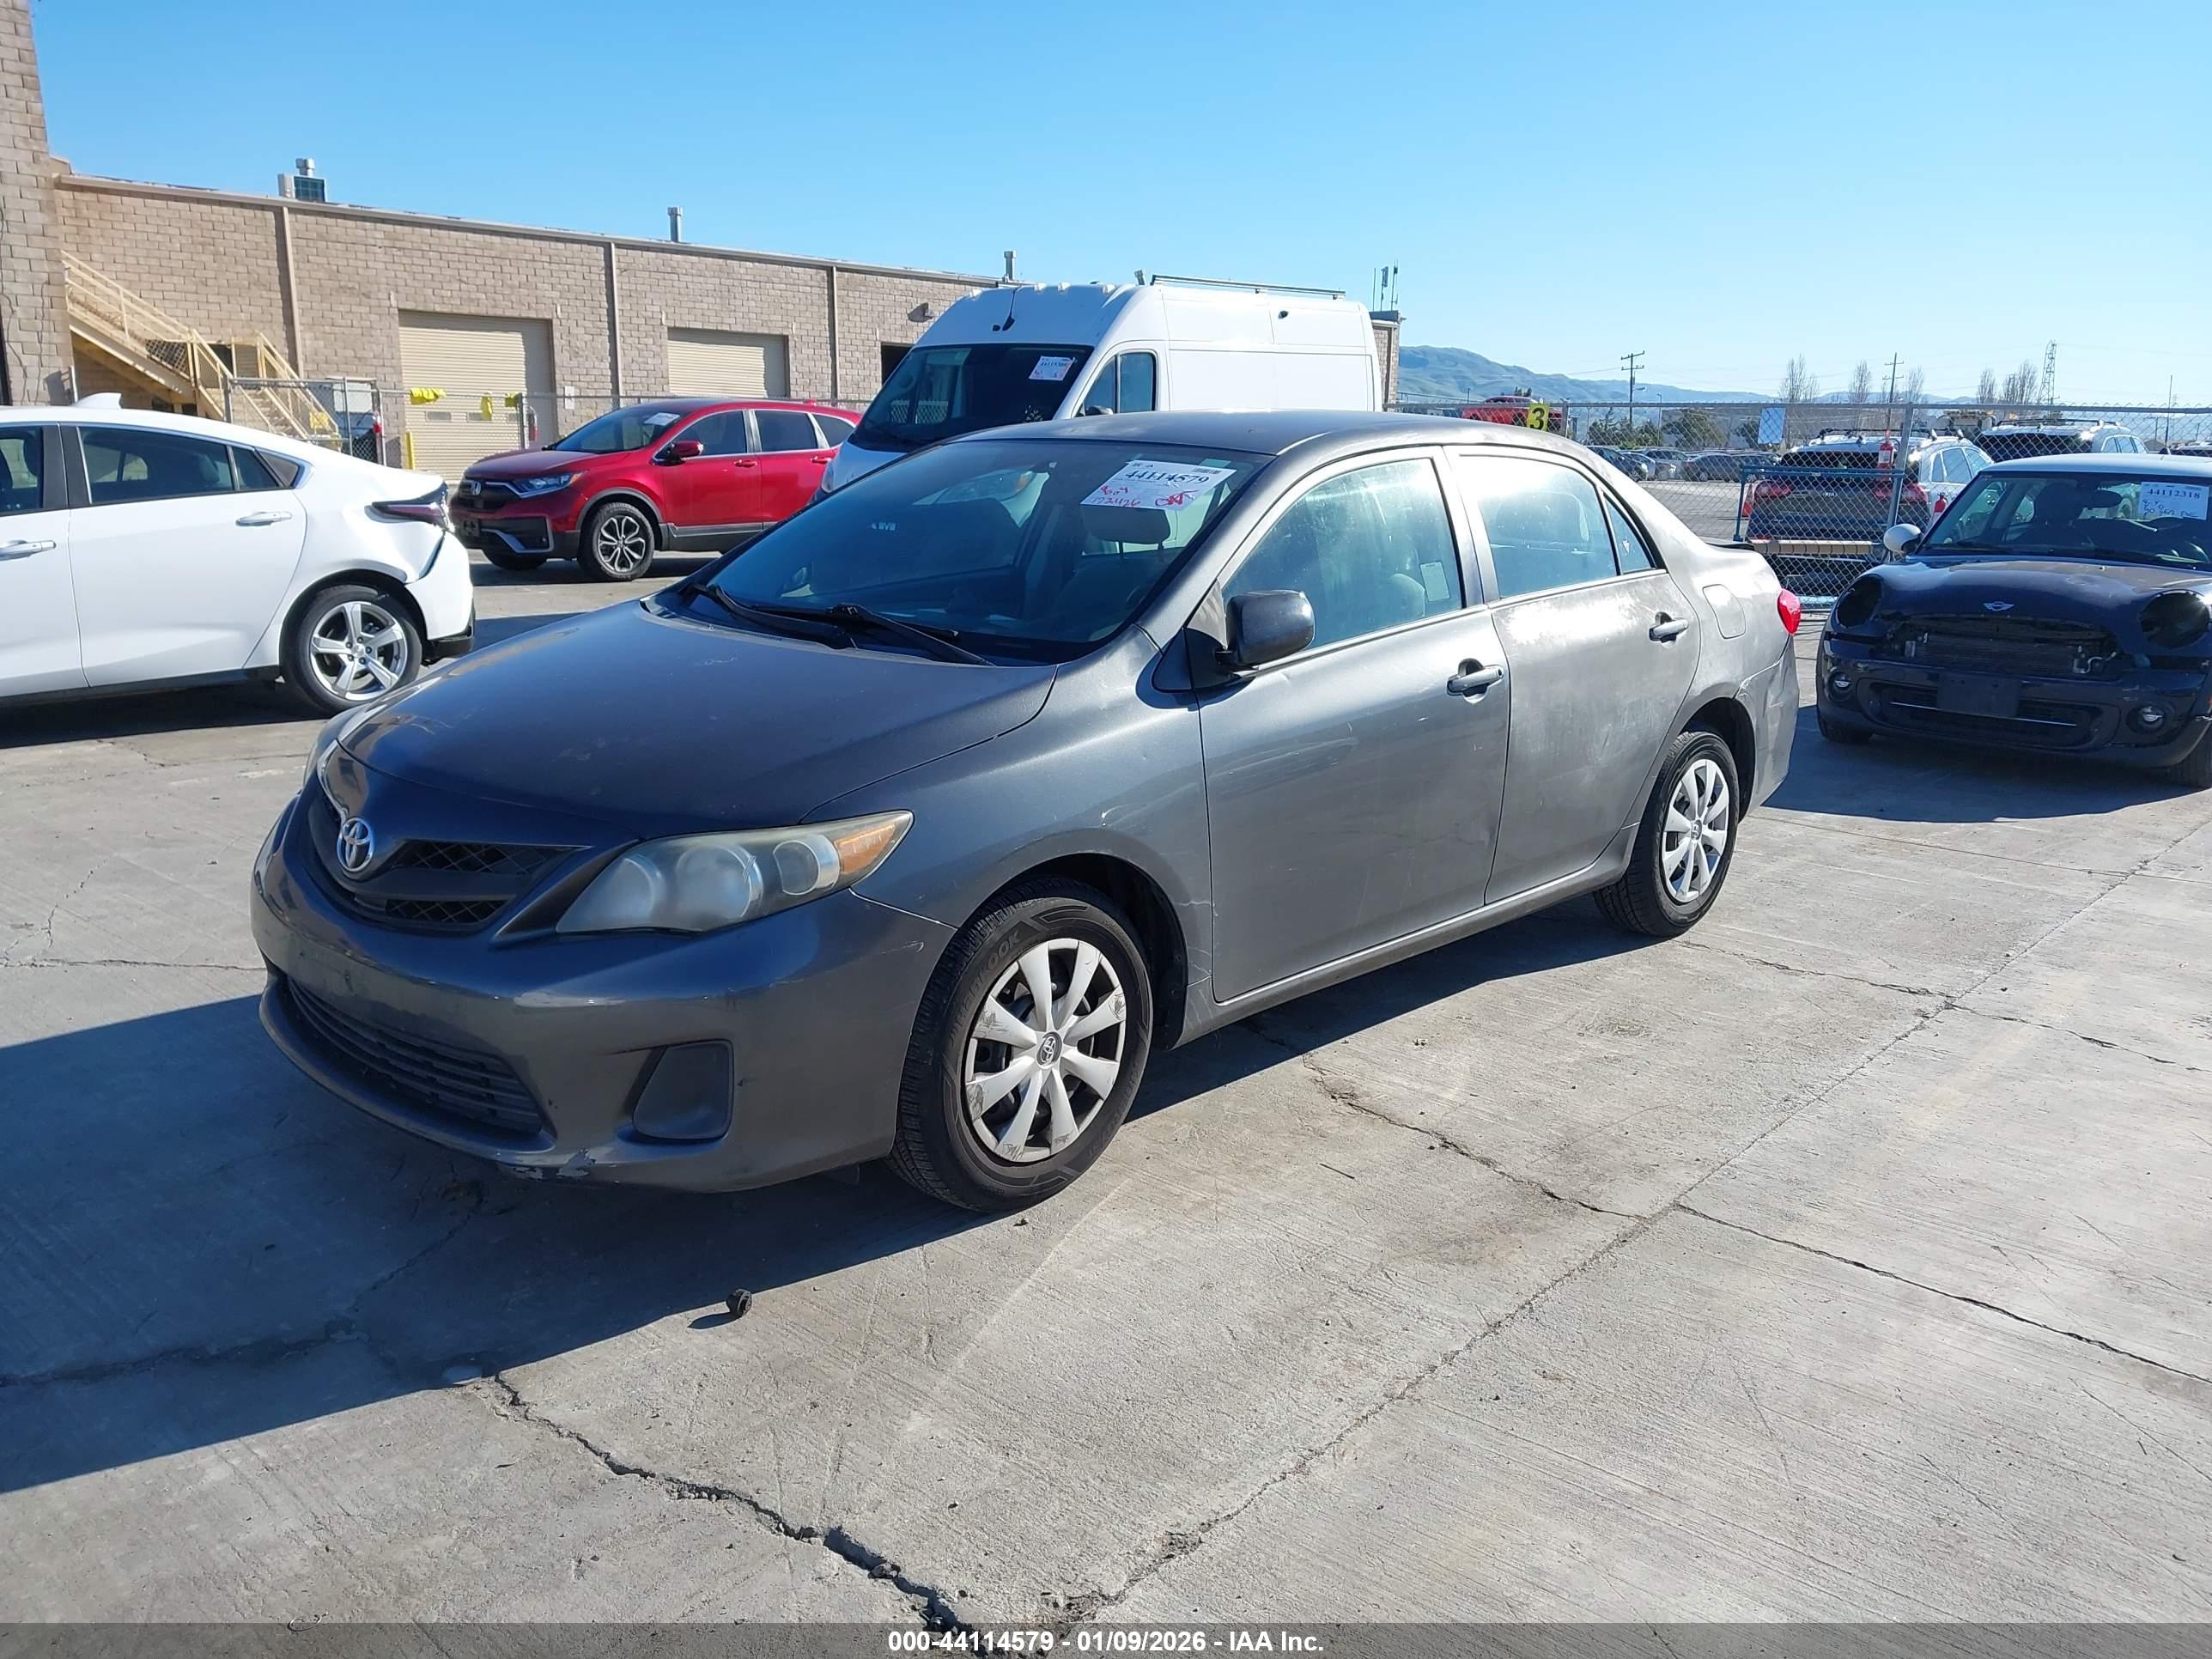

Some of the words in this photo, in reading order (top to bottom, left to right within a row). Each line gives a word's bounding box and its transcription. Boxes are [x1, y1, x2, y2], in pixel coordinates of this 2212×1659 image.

[1529, 407, 1545, 430] 3
[1125, 470, 1210, 484] 44114579
[2148, 488, 2200, 499] 44112318
